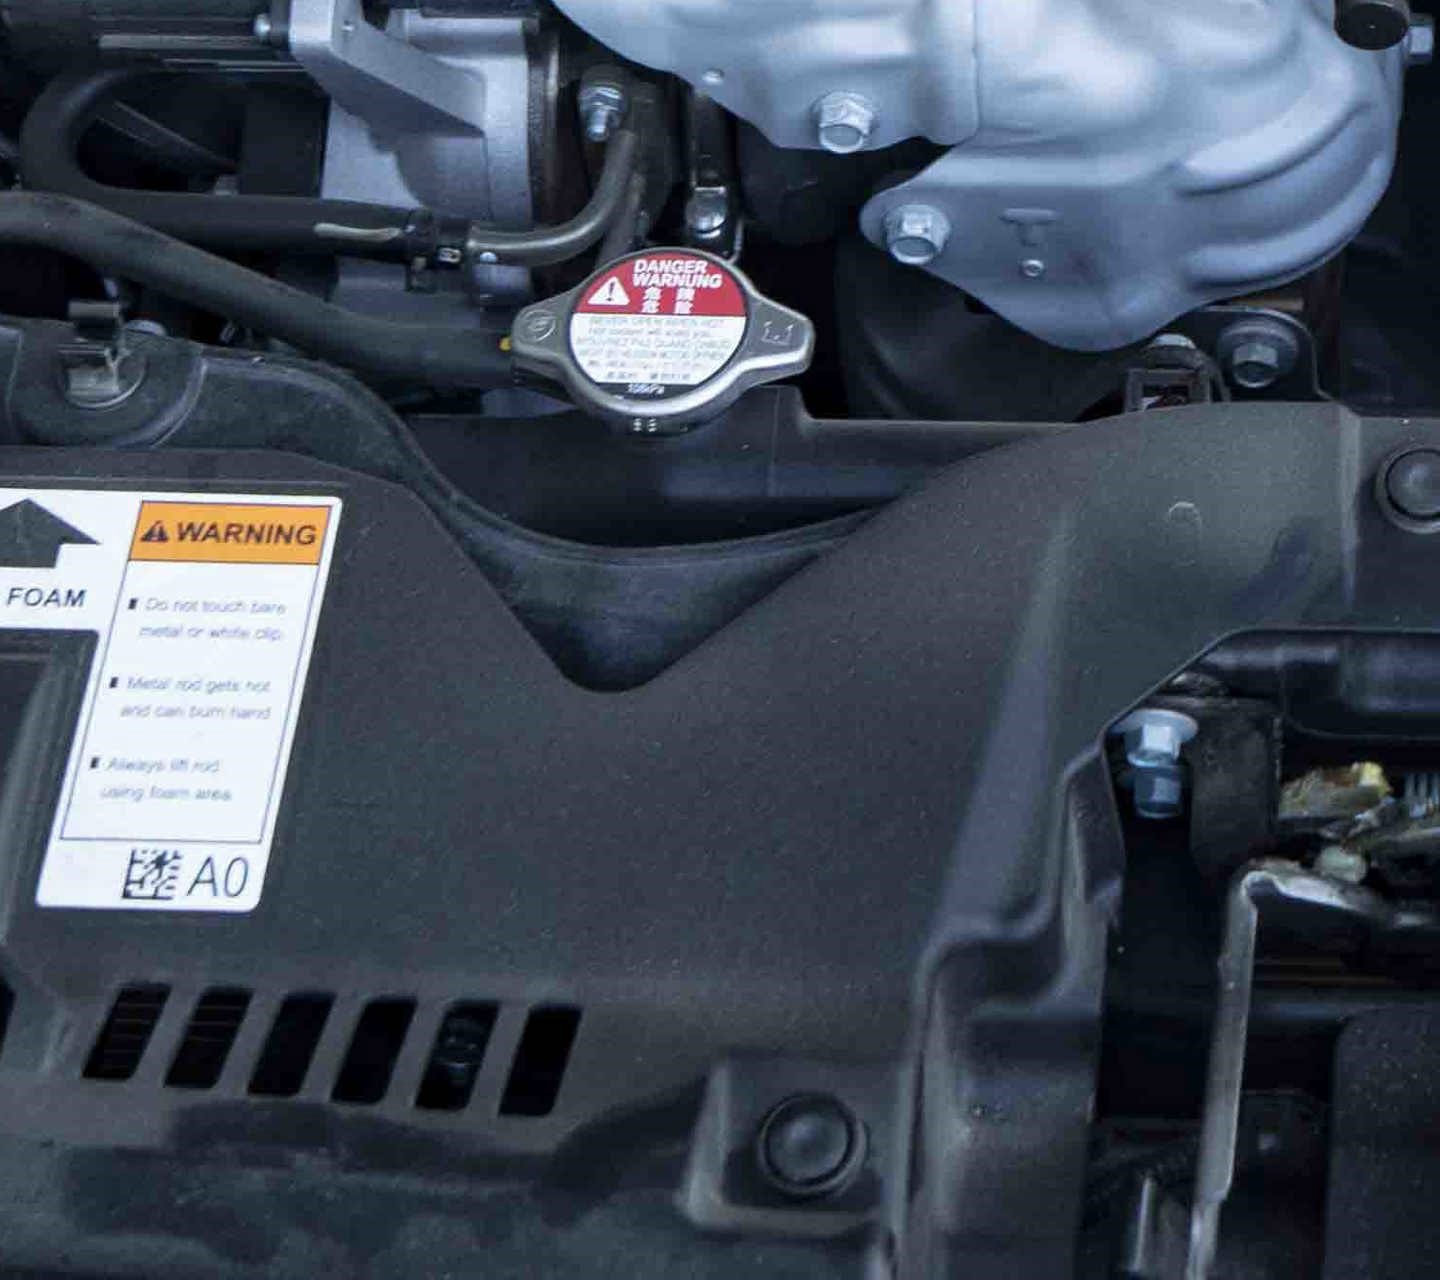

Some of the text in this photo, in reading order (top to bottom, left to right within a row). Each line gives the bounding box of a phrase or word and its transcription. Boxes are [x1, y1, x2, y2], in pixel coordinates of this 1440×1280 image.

[633, 258, 709, 274] DANGER
[632, 272, 724, 289] WARNUNG
[175, 520, 317, 546] WARNING
[8, 587, 88, 608] FOAM
[145, 597, 168, 611] Do
[202, 598, 244, 614] touch
[127, 675, 171, 689] Metal
[175, 677, 202, 691] rod
[205, 680, 241, 694] gets
[120, 704, 152, 717] and
[155, 706, 184, 718] can
[106, 757, 165, 773] Always
[192, 759, 220, 773] rod
[186, 856, 249, 898] A0
